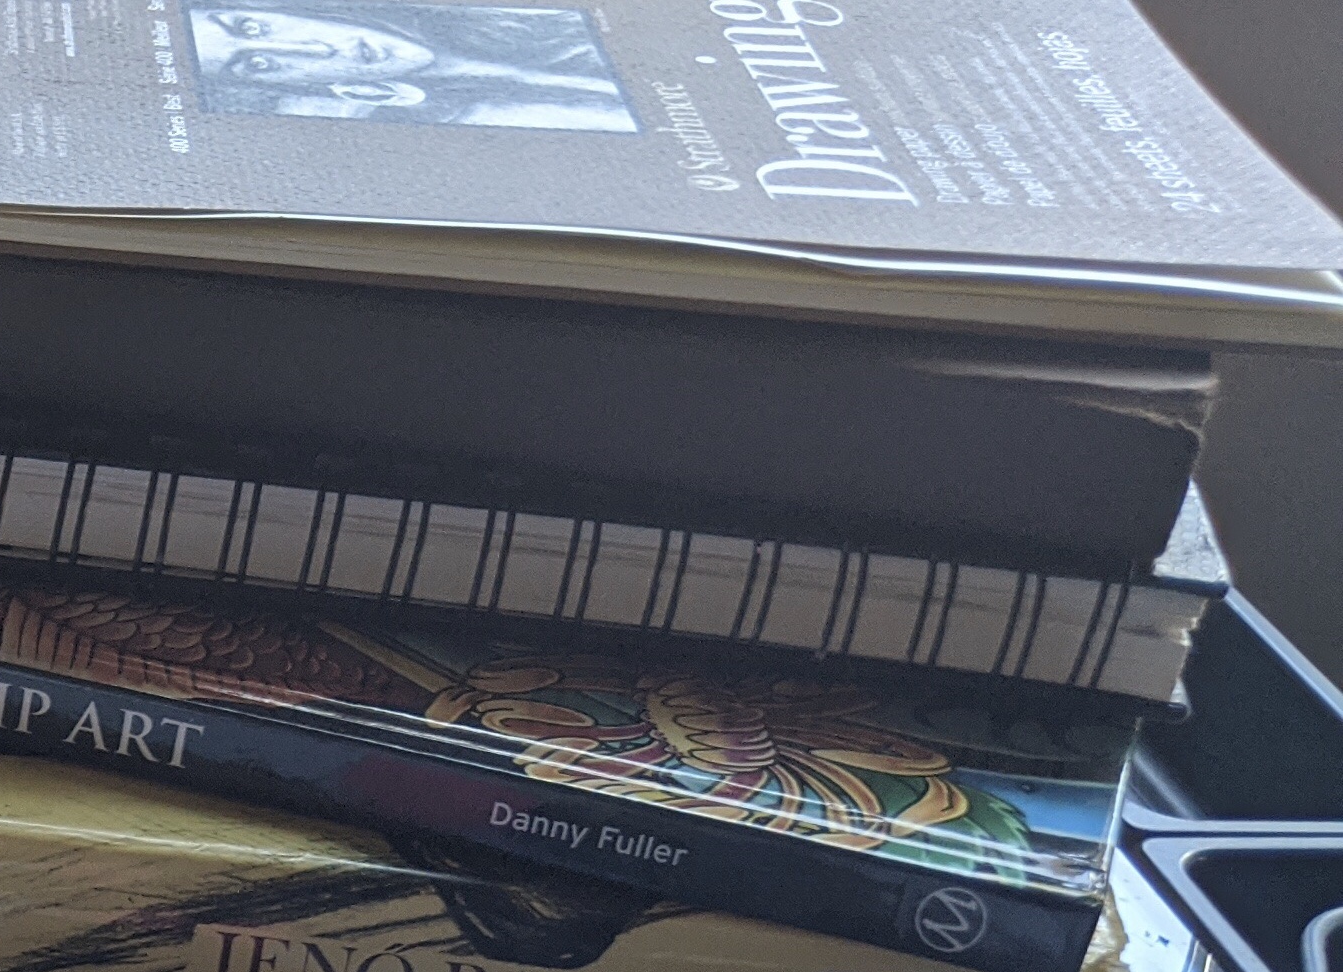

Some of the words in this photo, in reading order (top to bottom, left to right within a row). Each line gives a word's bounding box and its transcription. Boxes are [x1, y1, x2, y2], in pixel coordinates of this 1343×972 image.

[712, 0, 919, 207] Drawing
[62, 707, 204, 770] ART
[489, 801, 590, 850] Danny
[596, 827, 689, 868] Fuller
